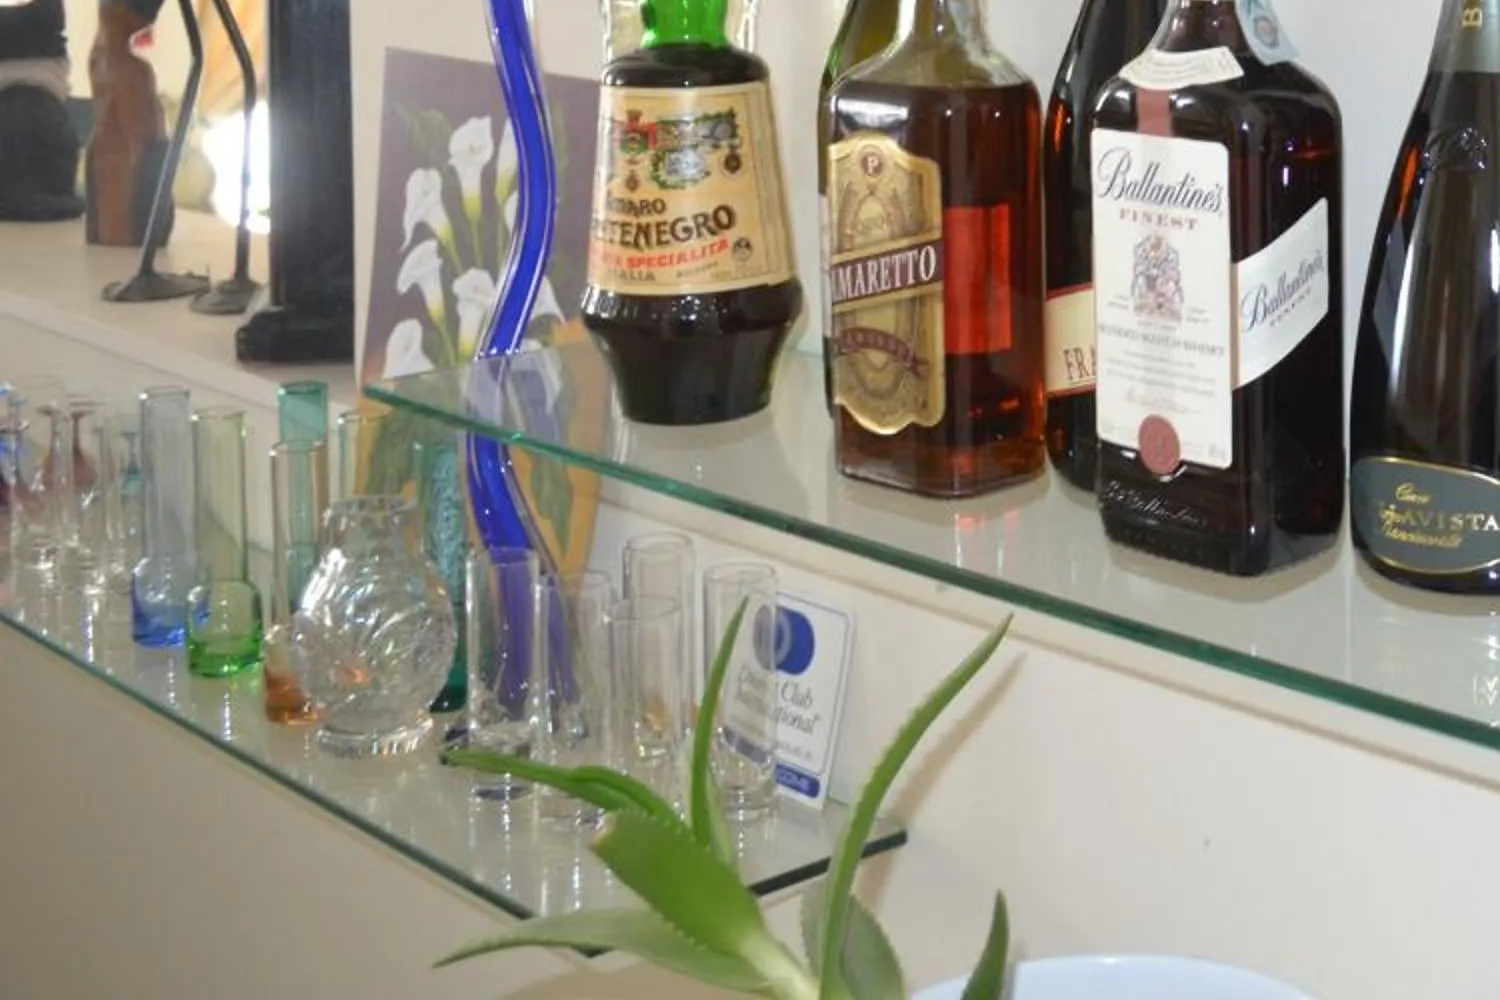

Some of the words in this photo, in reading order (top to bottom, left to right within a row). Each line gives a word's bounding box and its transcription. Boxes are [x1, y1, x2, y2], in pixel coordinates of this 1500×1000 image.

[867, 156, 878, 174] P
[1098, 146, 1226, 215] Ballantine's
[1119, 207, 1198, 231] FINEST
